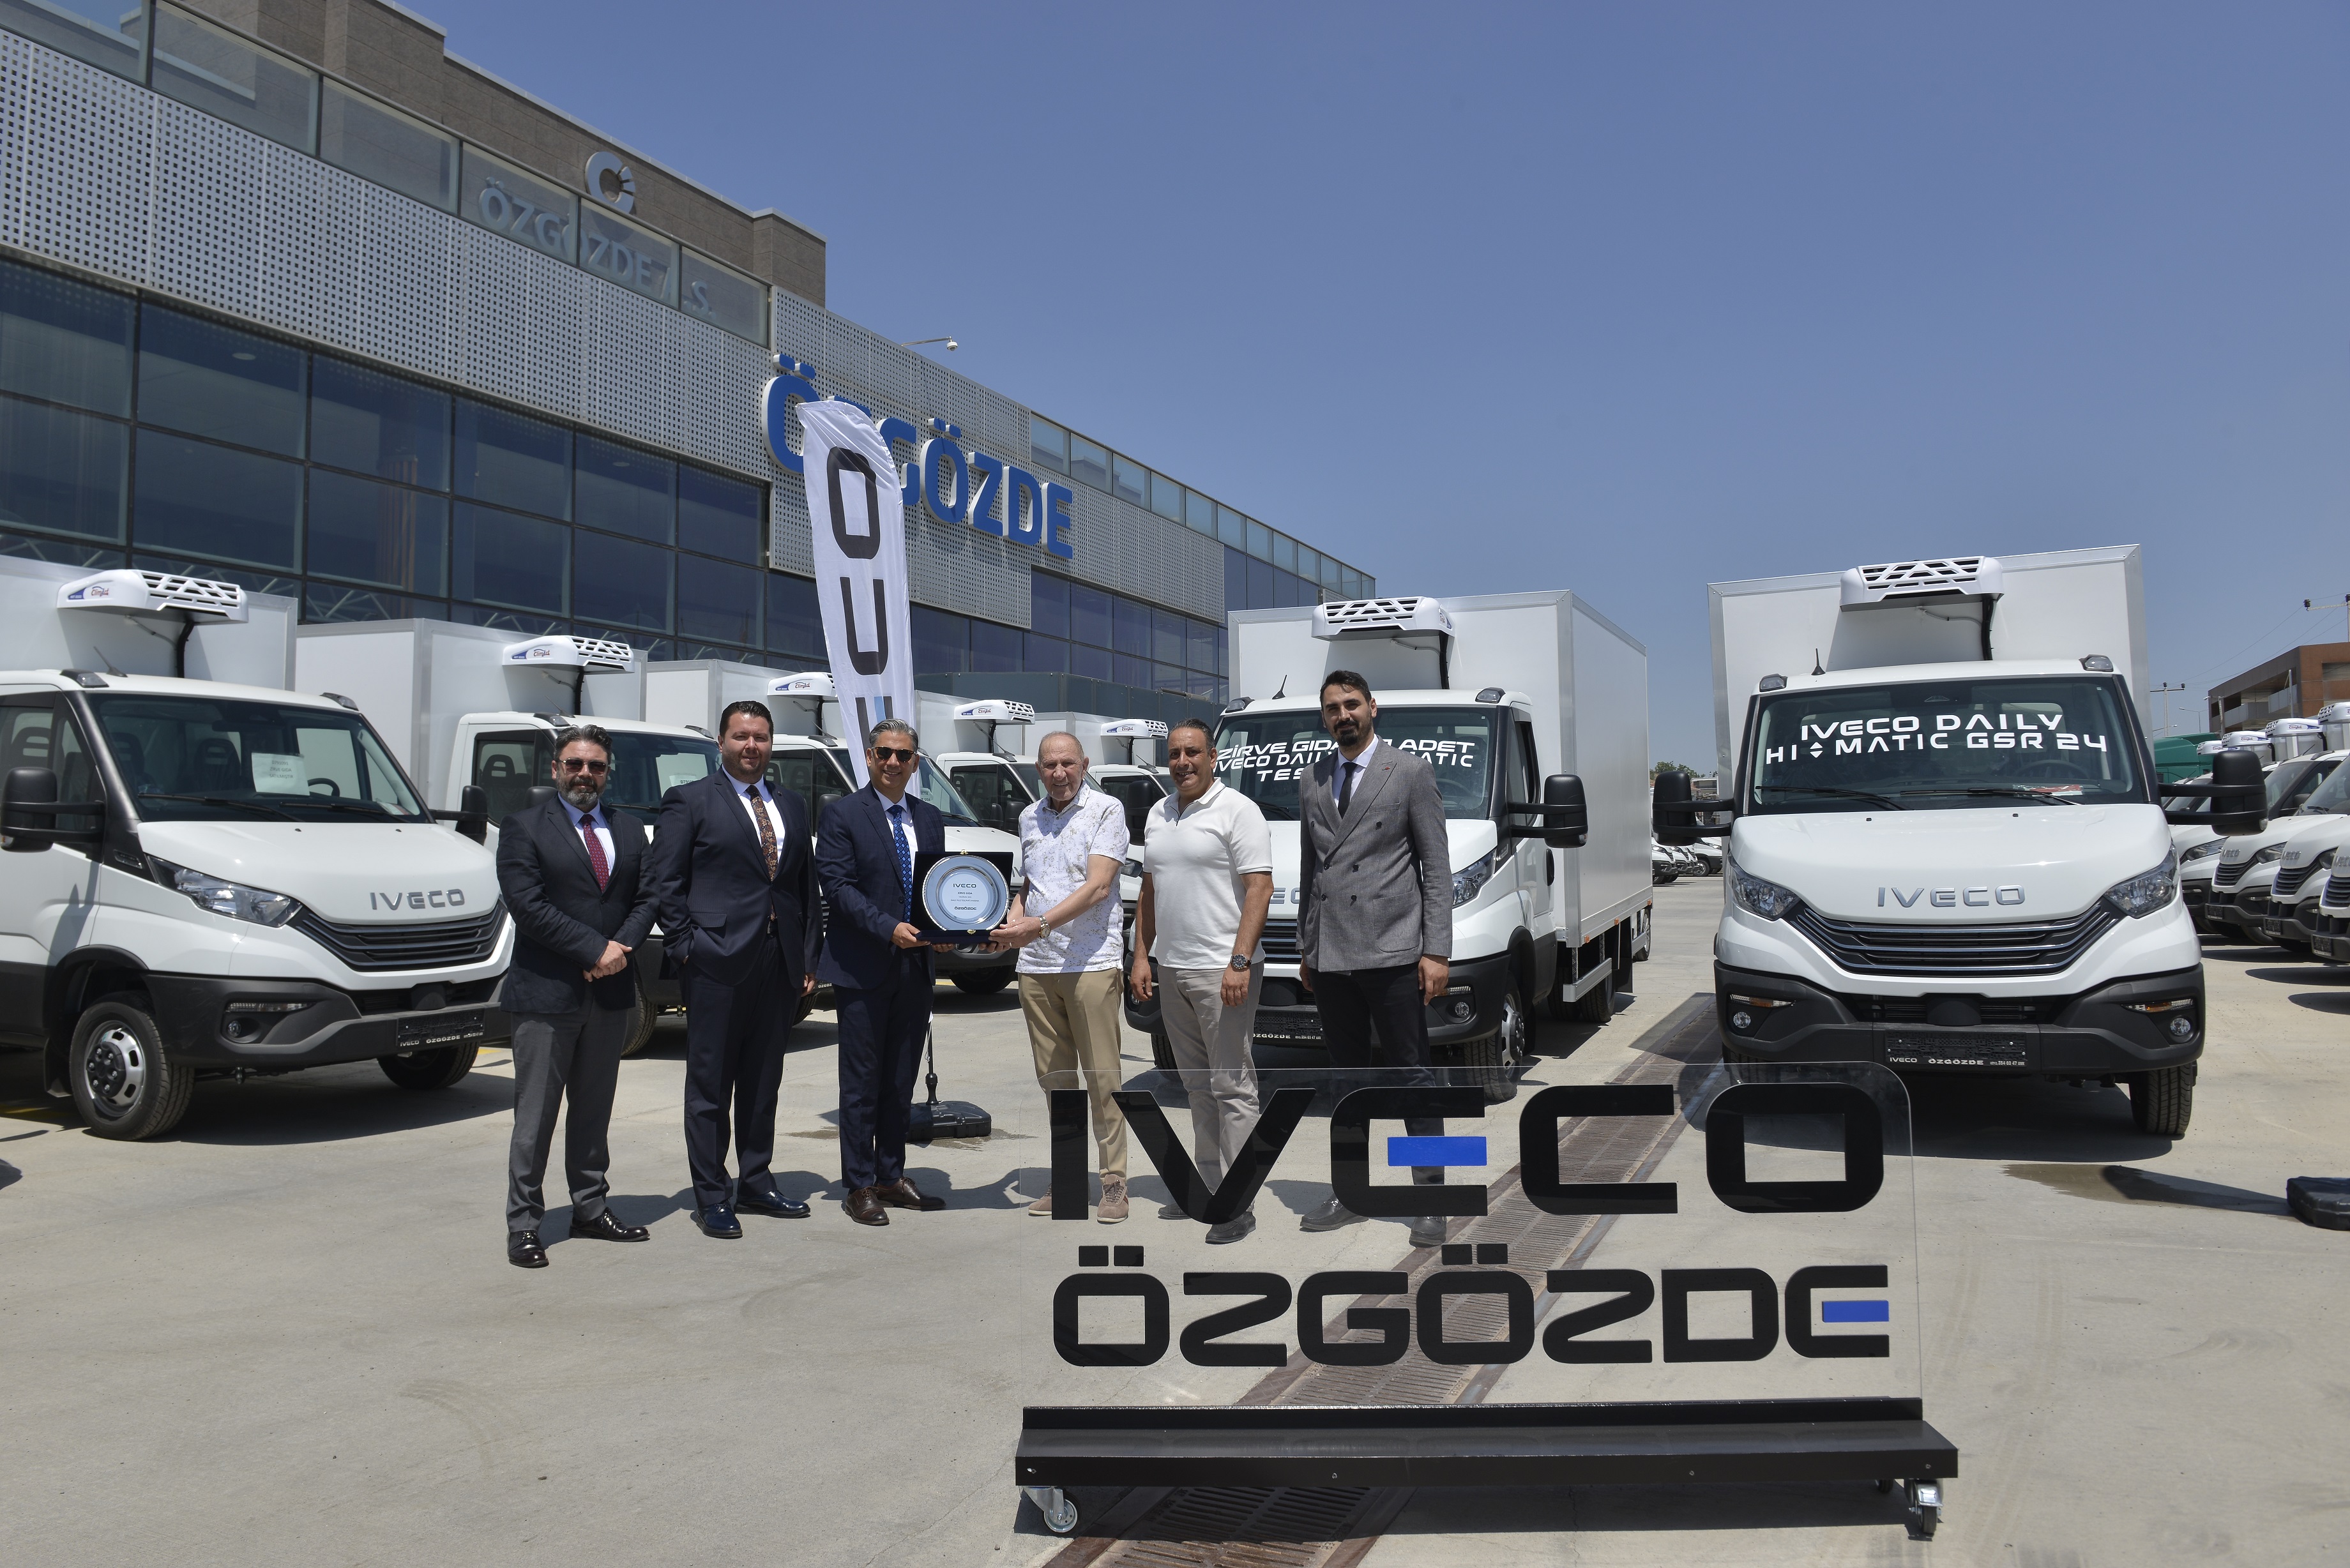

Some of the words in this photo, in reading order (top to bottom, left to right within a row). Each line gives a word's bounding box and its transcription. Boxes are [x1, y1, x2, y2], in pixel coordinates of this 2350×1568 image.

[763, 354, 1073, 559] ÖGÖZDE
[1801, 716, 1919, 741] IVECO
[1937, 714, 2063, 730] DAILY
[1399, 739, 1474, 753] ADET
[1967, 732, 2043, 749] GSR
[2058, 734, 2107, 752] 24
[1277, 751, 1332, 765] DAIL
[1409, 751, 1473, 767] ATIC
[370, 889, 465, 910] IVECO
[1877, 884, 2026, 908] IVECO
[1050, 1083, 1884, 1225] IVECO
[1053, 1244, 1890, 1367] ÖZGÖZDE
